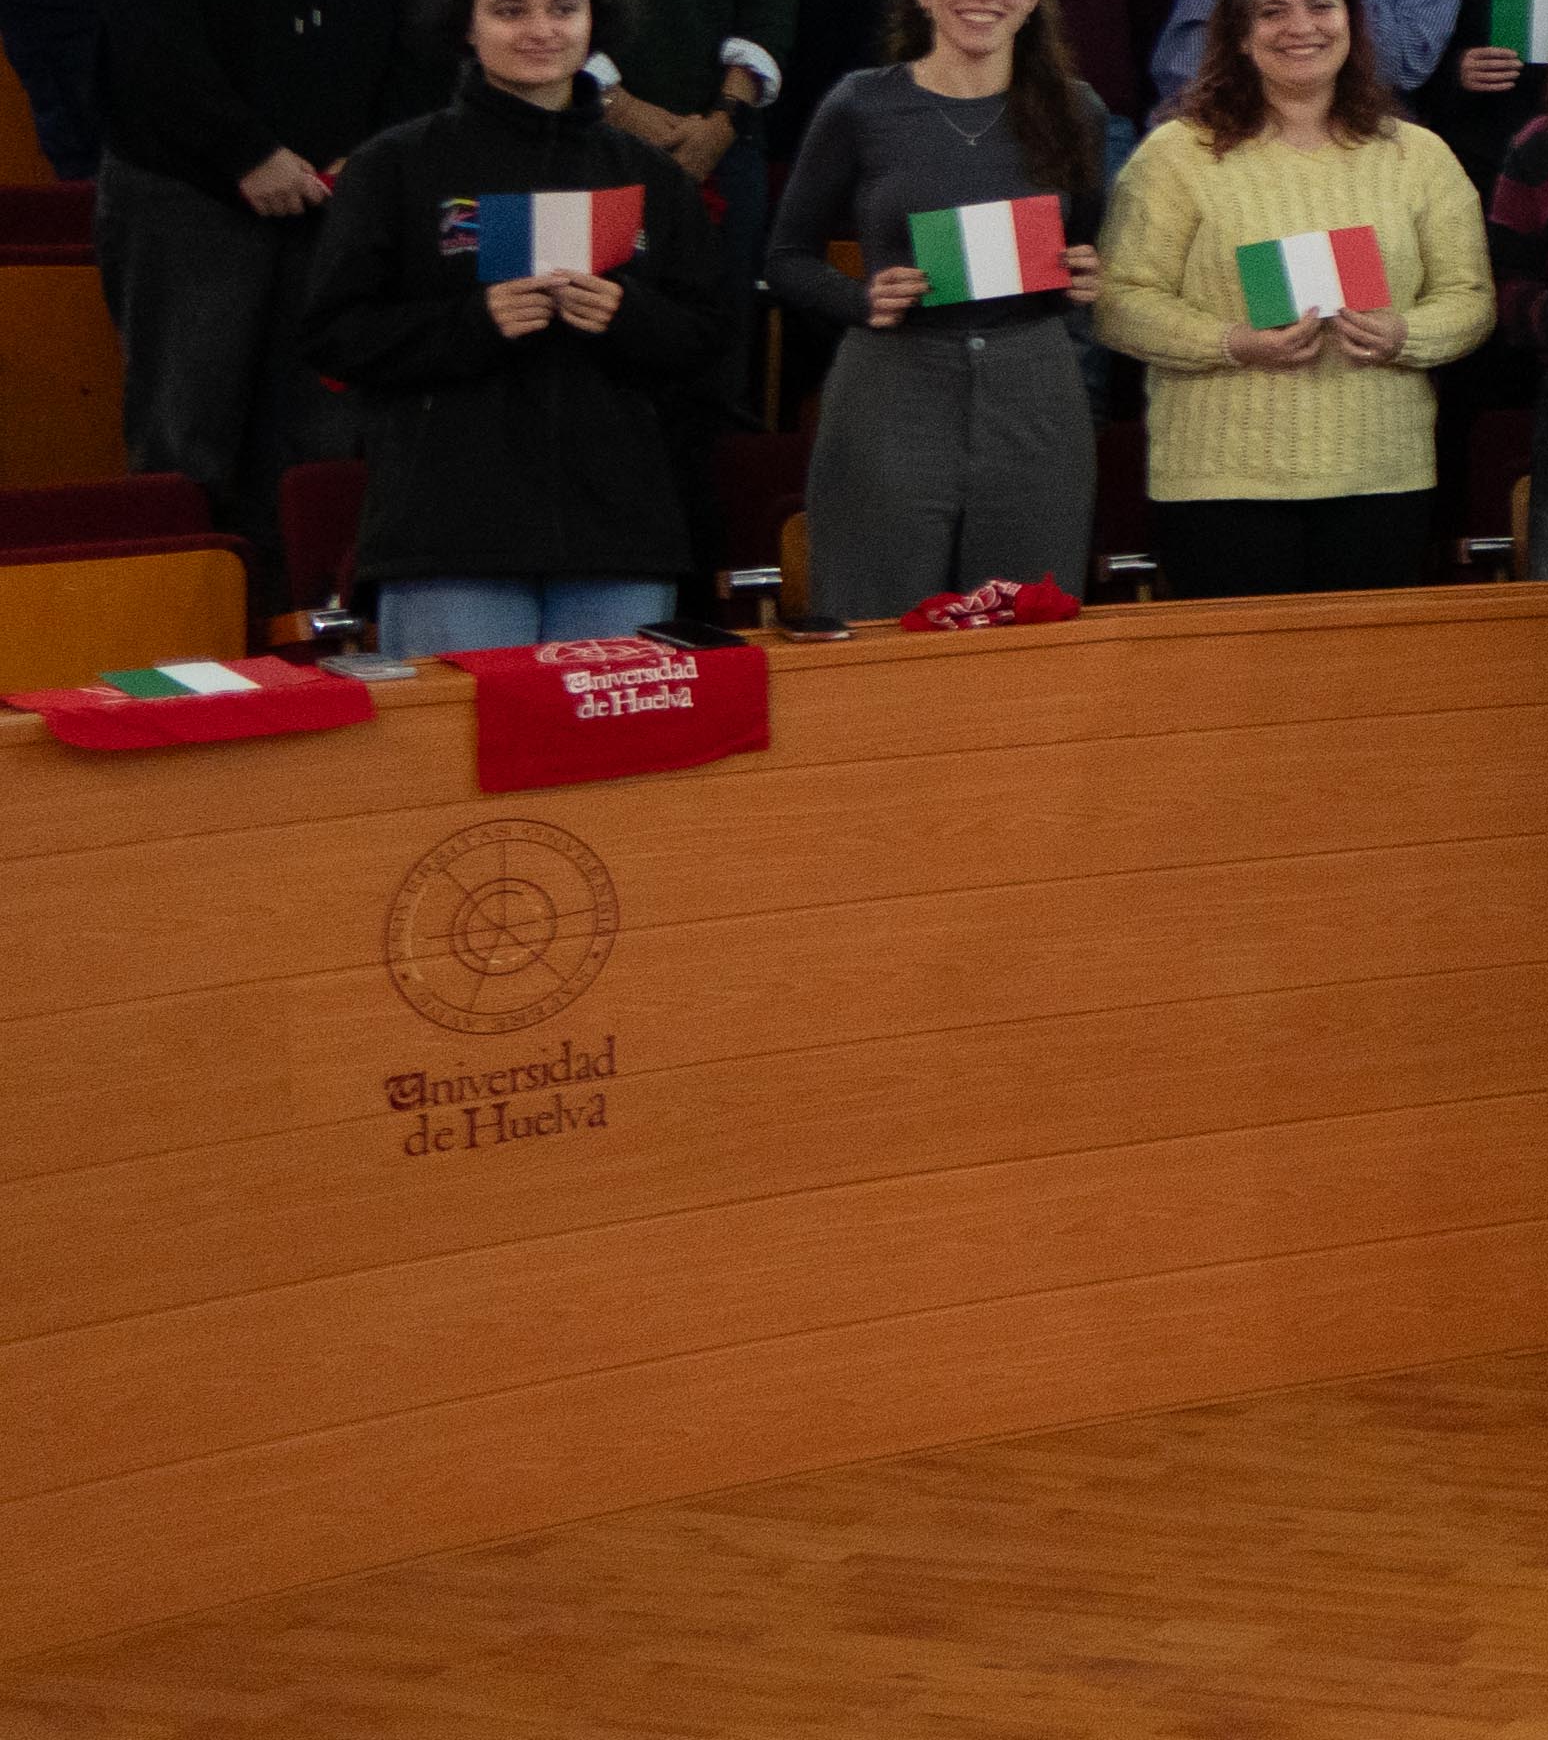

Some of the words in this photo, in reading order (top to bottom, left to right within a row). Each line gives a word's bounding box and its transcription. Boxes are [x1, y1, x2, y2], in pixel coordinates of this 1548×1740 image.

[563, 656, 699, 694] Universidad
[577, 694, 609, 719] de
[608, 685, 694, 716] Huelva
[384, 1034, 618, 1110] Universidad
[404, 1114, 454, 1156] de
[463, 1093, 609, 1149] Huelva
